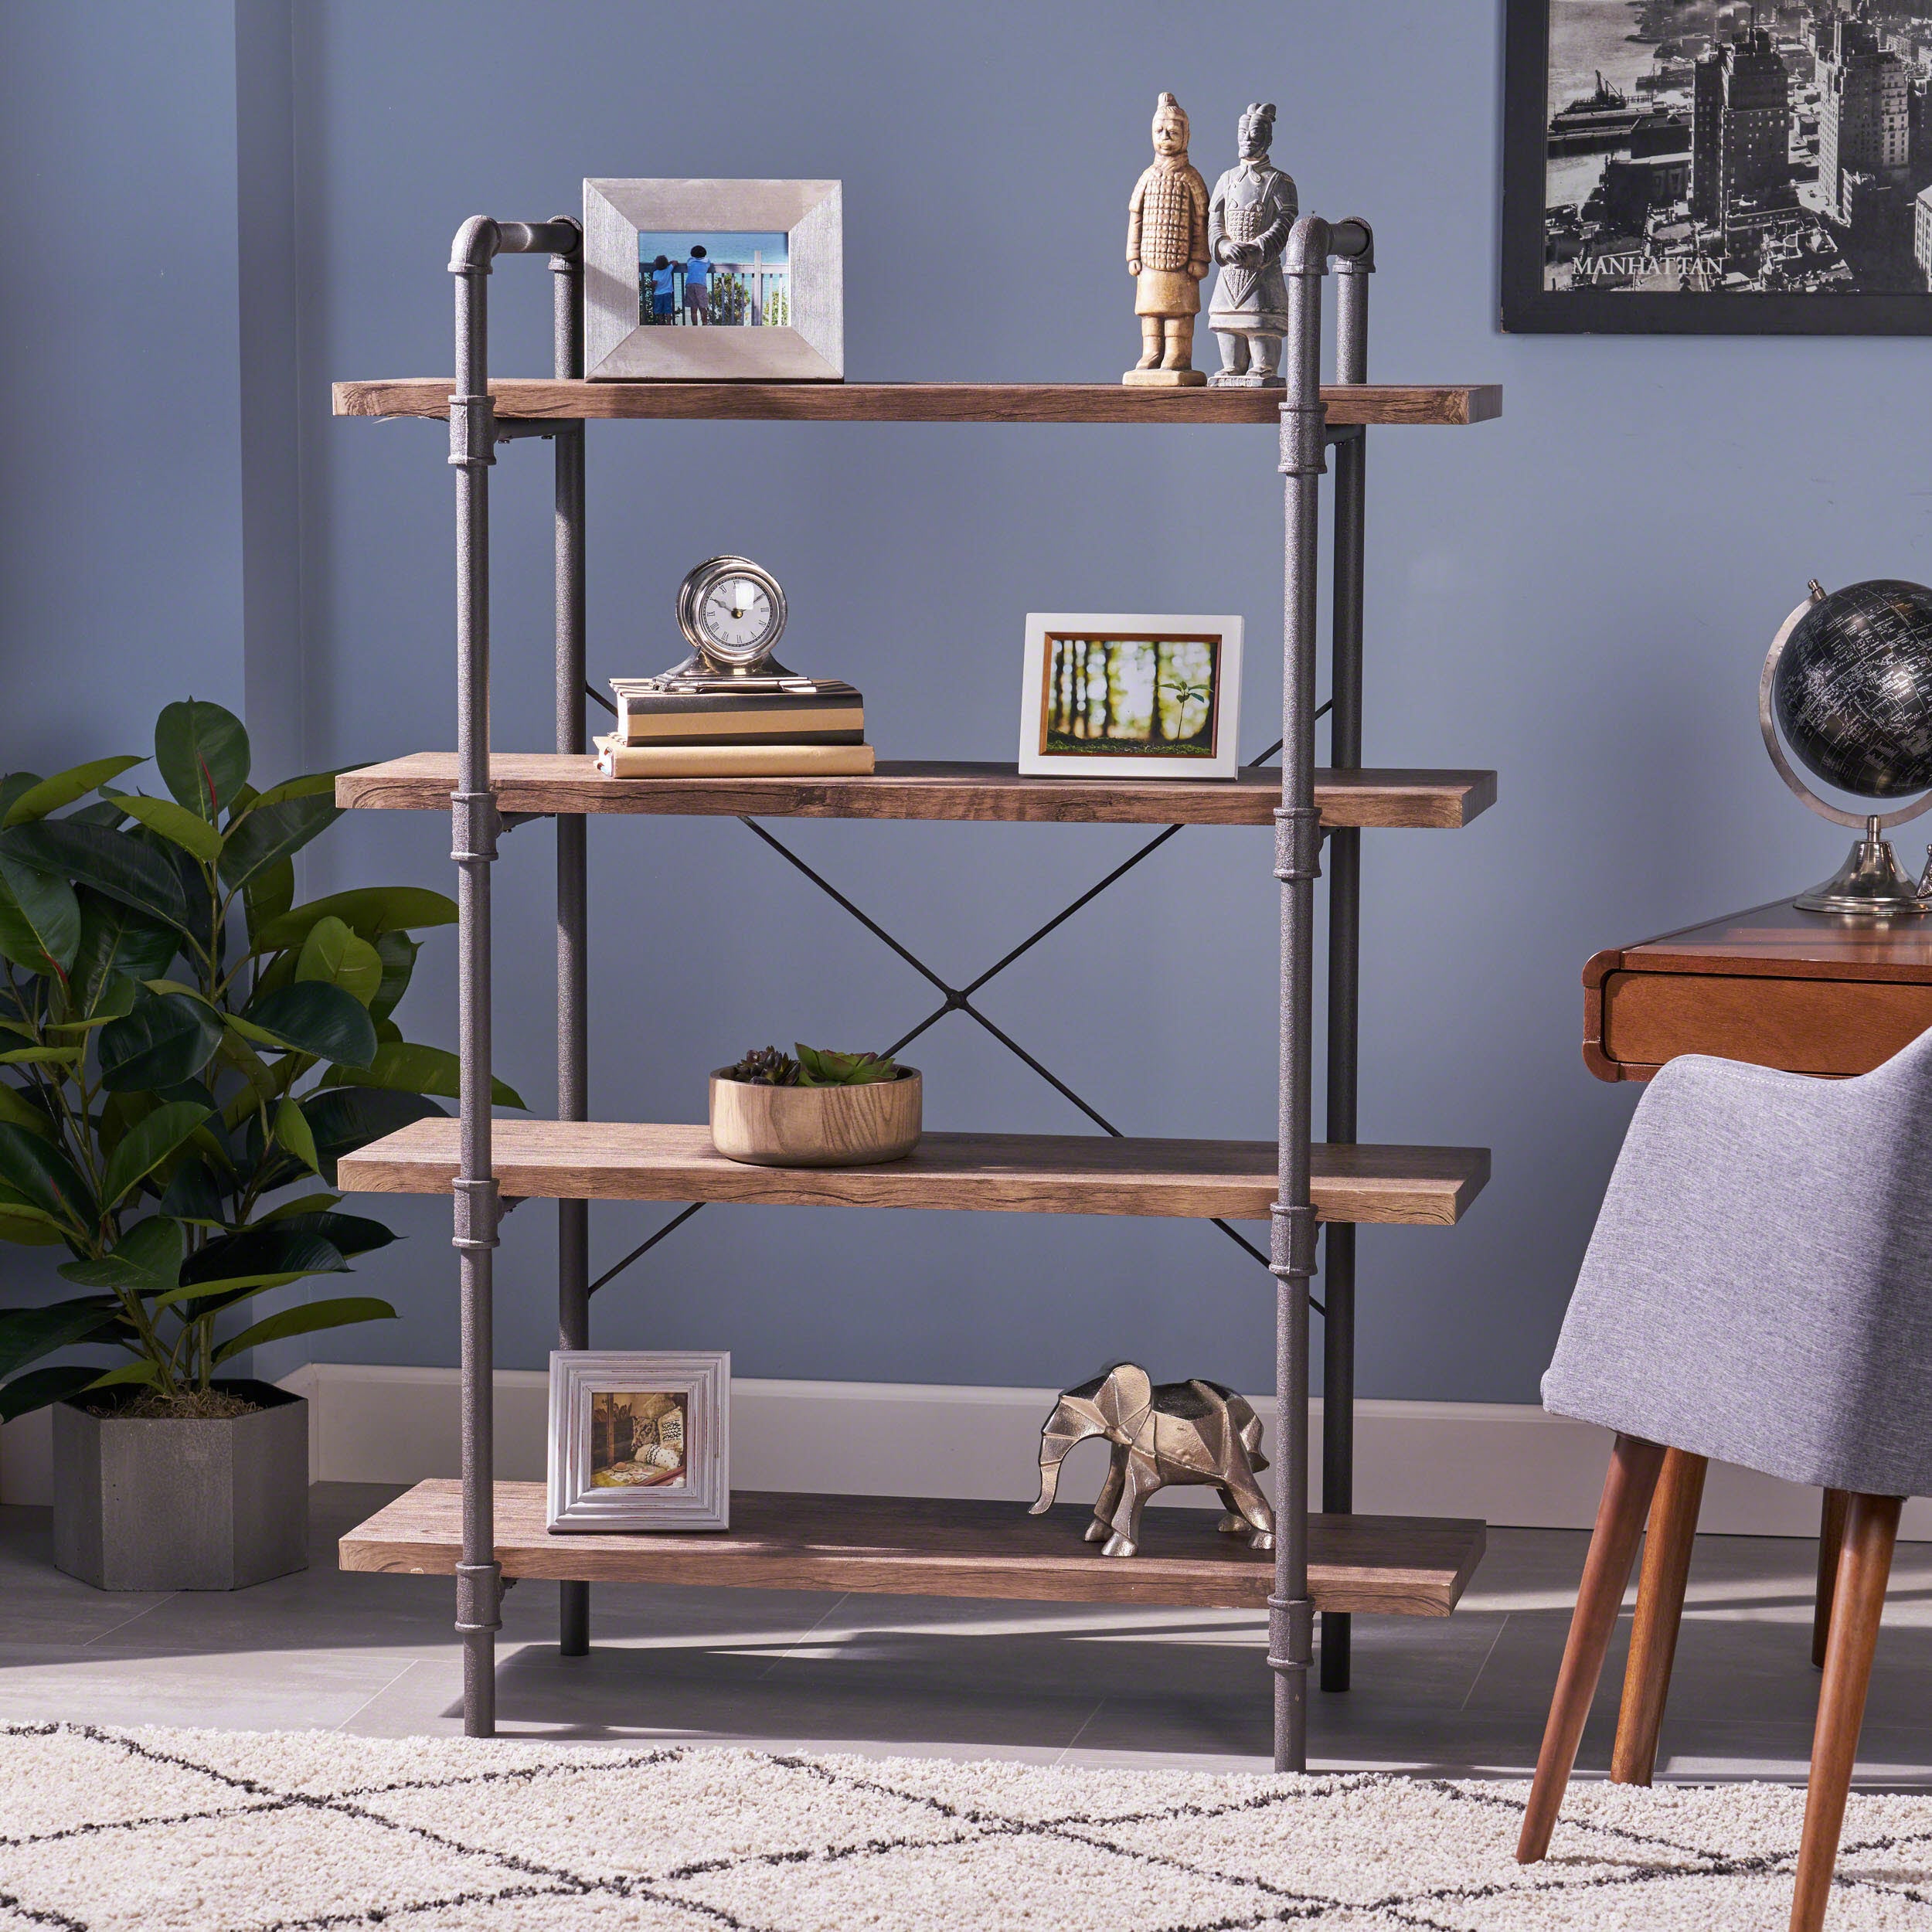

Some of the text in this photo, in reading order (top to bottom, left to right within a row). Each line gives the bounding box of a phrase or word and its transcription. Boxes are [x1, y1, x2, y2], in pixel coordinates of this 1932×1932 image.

[1572, 257, 1724, 275] MANHATTAN
[1878, 679, 1900, 695] AUSTRALIA
[1894, 687, 1913, 699] PACIFIC
